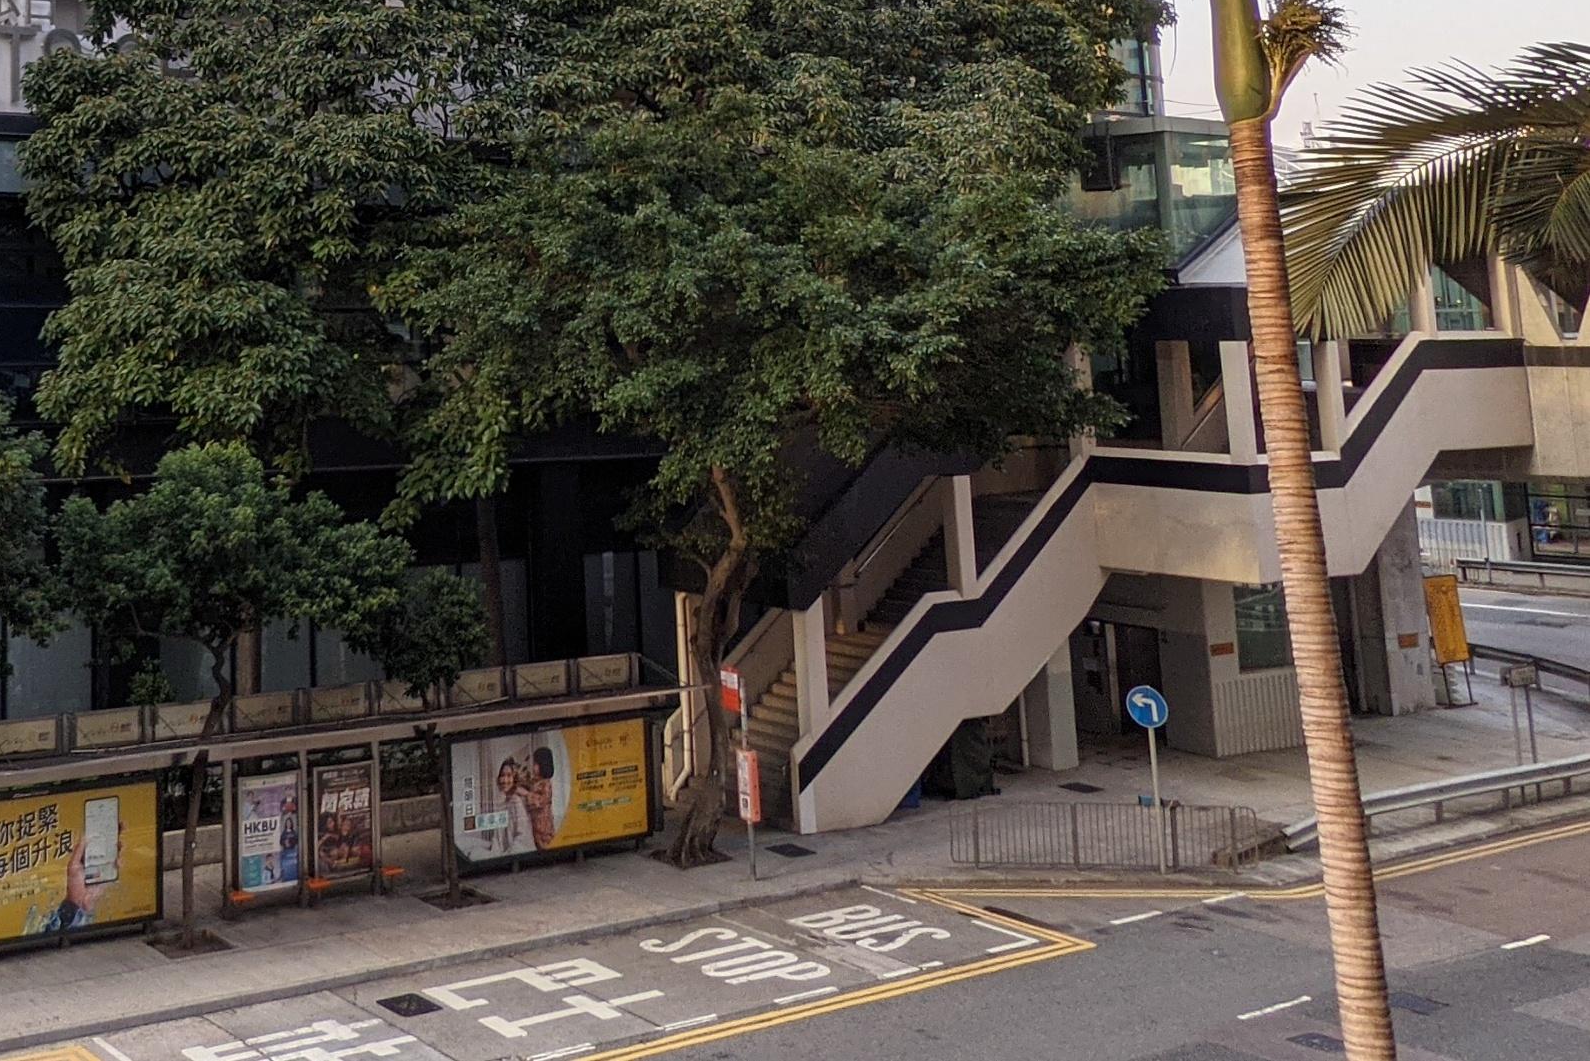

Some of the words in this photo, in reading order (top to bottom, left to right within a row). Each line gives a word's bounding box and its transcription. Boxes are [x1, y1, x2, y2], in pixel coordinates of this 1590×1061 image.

[244, 819, 277, 835] HKBU
[786, 904, 951, 952] BUS
[639, 927, 831, 984] STOP
[421, 958, 665, 1038] 巴士
